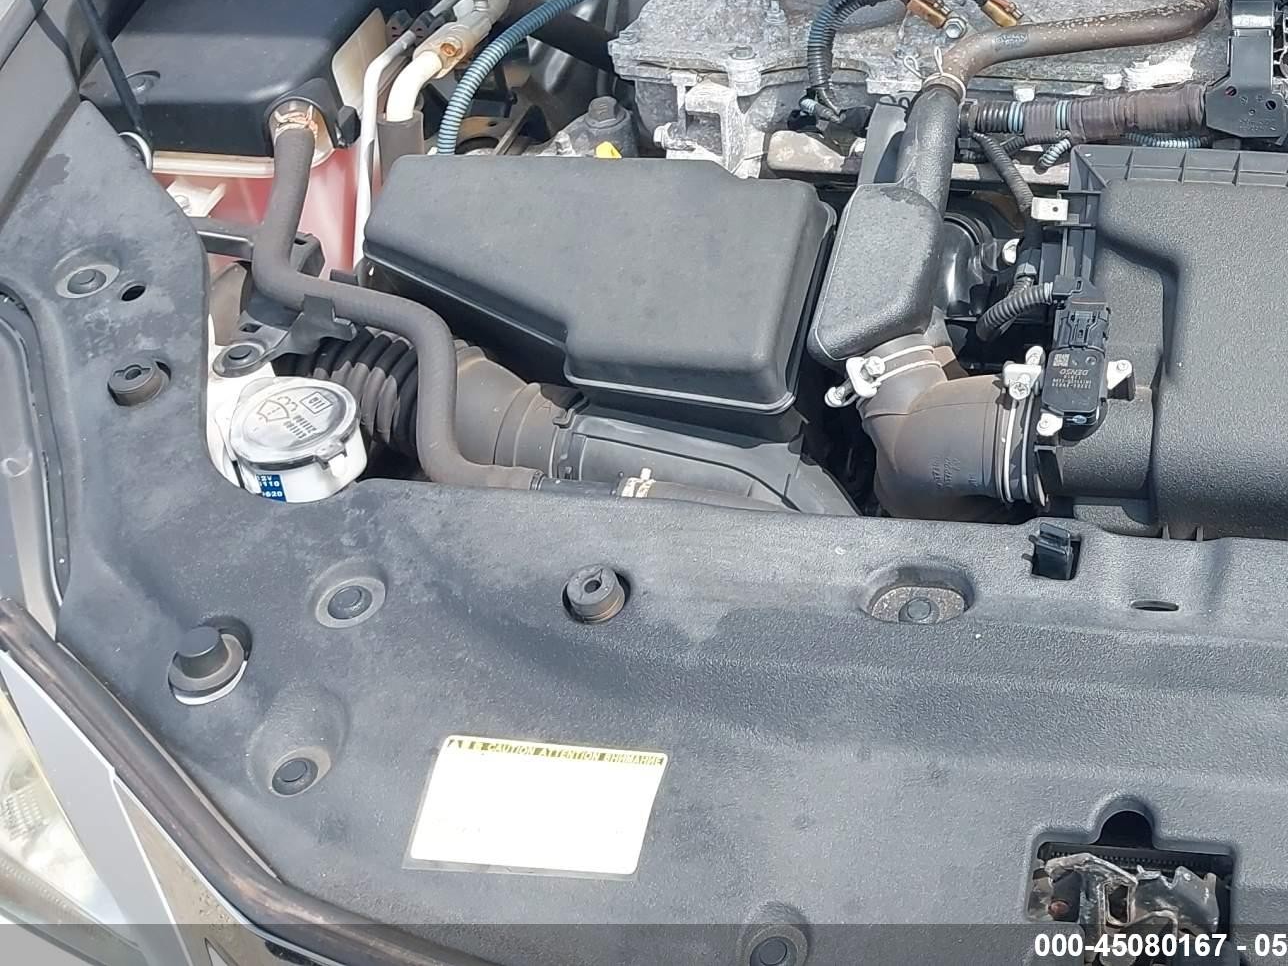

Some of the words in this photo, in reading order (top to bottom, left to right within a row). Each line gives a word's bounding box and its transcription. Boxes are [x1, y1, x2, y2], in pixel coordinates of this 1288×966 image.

[1059, 368, 1090, 376] DENSO
[488, 744, 535, 755] CAUTION
[540, 747, 599, 761] ATTENTION
[604, 753, 663, 765] ВНИМАНИЕ
